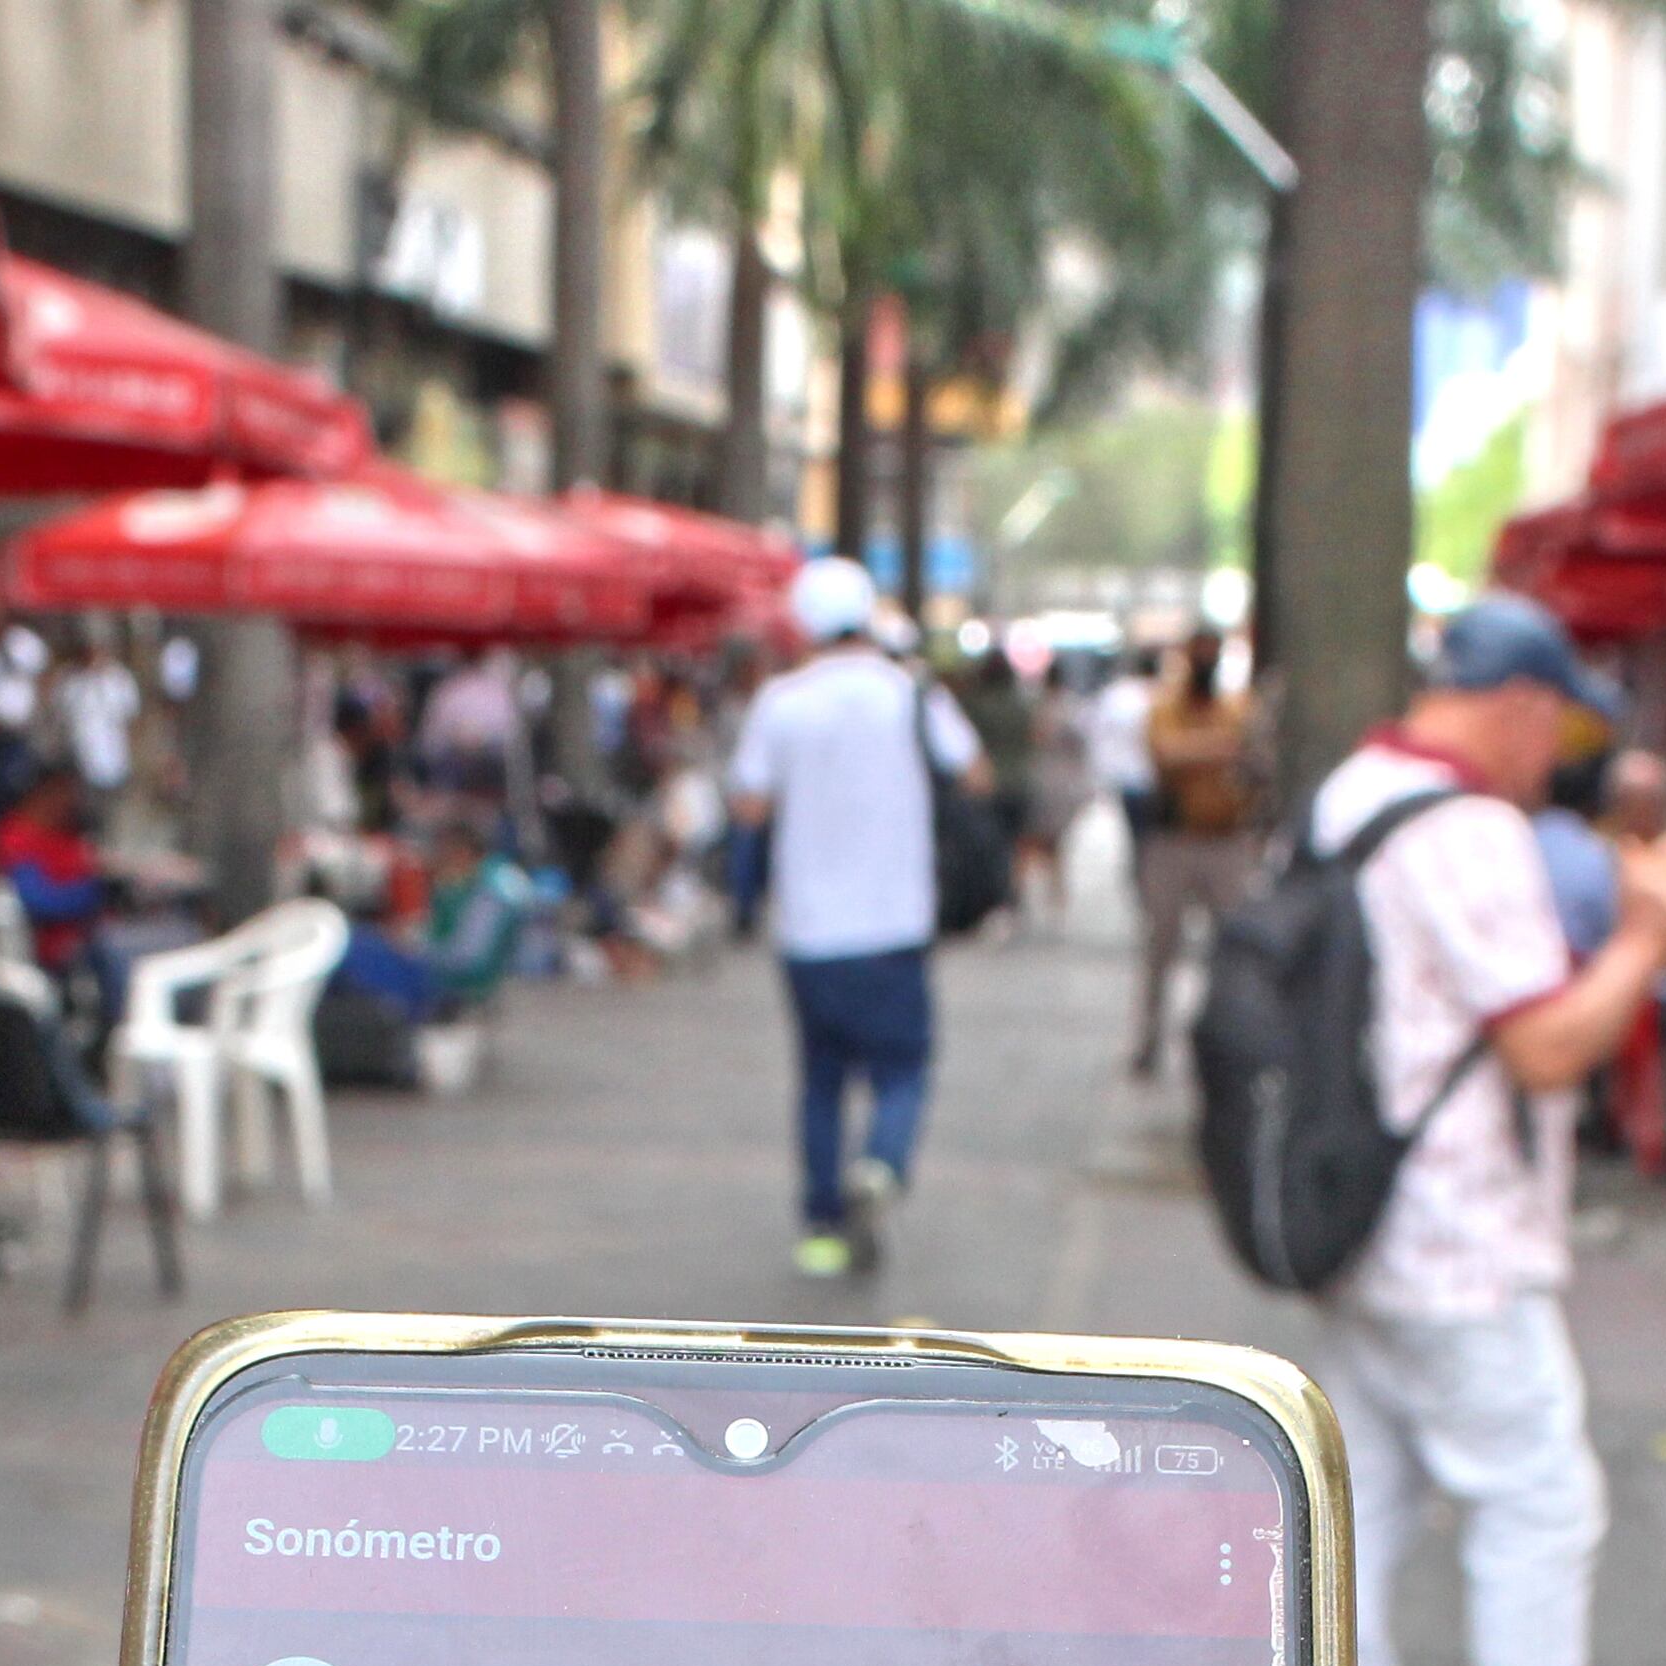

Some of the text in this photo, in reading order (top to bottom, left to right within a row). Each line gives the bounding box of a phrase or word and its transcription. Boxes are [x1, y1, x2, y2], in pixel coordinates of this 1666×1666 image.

[395, 1424, 533, 1455] 2:27 PM
[1174, 1452, 1200, 1470] 75
[244, 1517, 502, 1563] Sonómetro
